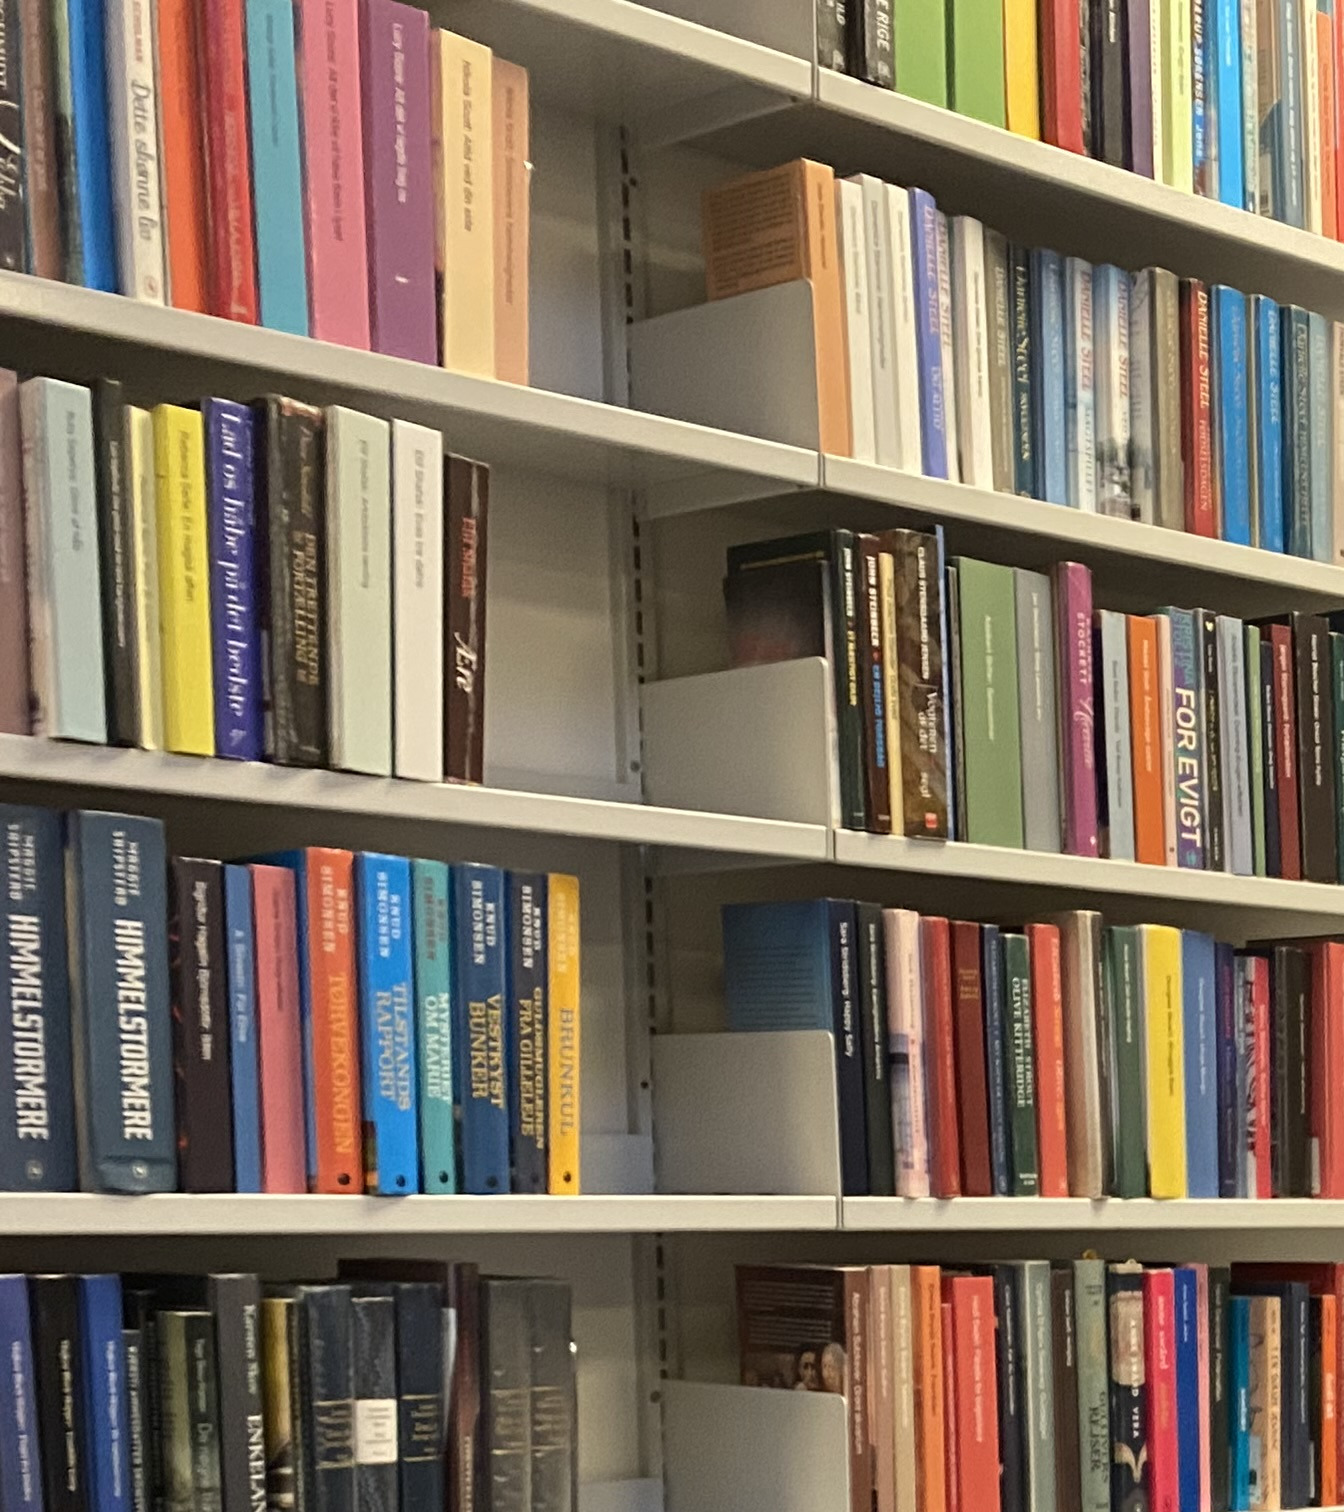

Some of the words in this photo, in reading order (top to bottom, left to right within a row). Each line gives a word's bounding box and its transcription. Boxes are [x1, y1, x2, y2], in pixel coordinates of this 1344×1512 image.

[130, 80, 152, 135] Dette
[1196, 292, 1208, 359] DANIELLE
[1199, 365, 1210, 409] STEEL
[1173, 687, 1196, 750] FOR
[1176, 756, 1202, 848] EVIGT
[471, 880, 485, 965] SIMONSEN
[485, 902, 496, 947] KNUD
[522, 885, 534, 969] SIMONSEN
[8, 914, 49, 1141] HIMMELSTORMERE
[113, 919, 154, 1142] HIMMELSTORMERE
[425, 995, 440, 1027] OM
[518, 999, 533, 1035] FRA
[1011, 977, 1022, 1019] OLIVE
[376, 989, 397, 1102] RAPPORT
[392, 981, 411, 1111] TILSTANDS
[426, 1033, 442, 1099] MARIE
[468, 1001, 488, 1099] BUNKER
[486, 993, 504, 1109] VESTKYST
[560, 1007, 575, 1136] BRUNKUL
[1012, 1022, 1026, 1108] KITTERIDGE
[1023, 1056, 1033, 1106] STROUT
[520, 1039, 534, 1137] GILLELEJE
[1089, 1406, 1101, 1472] REJSER
